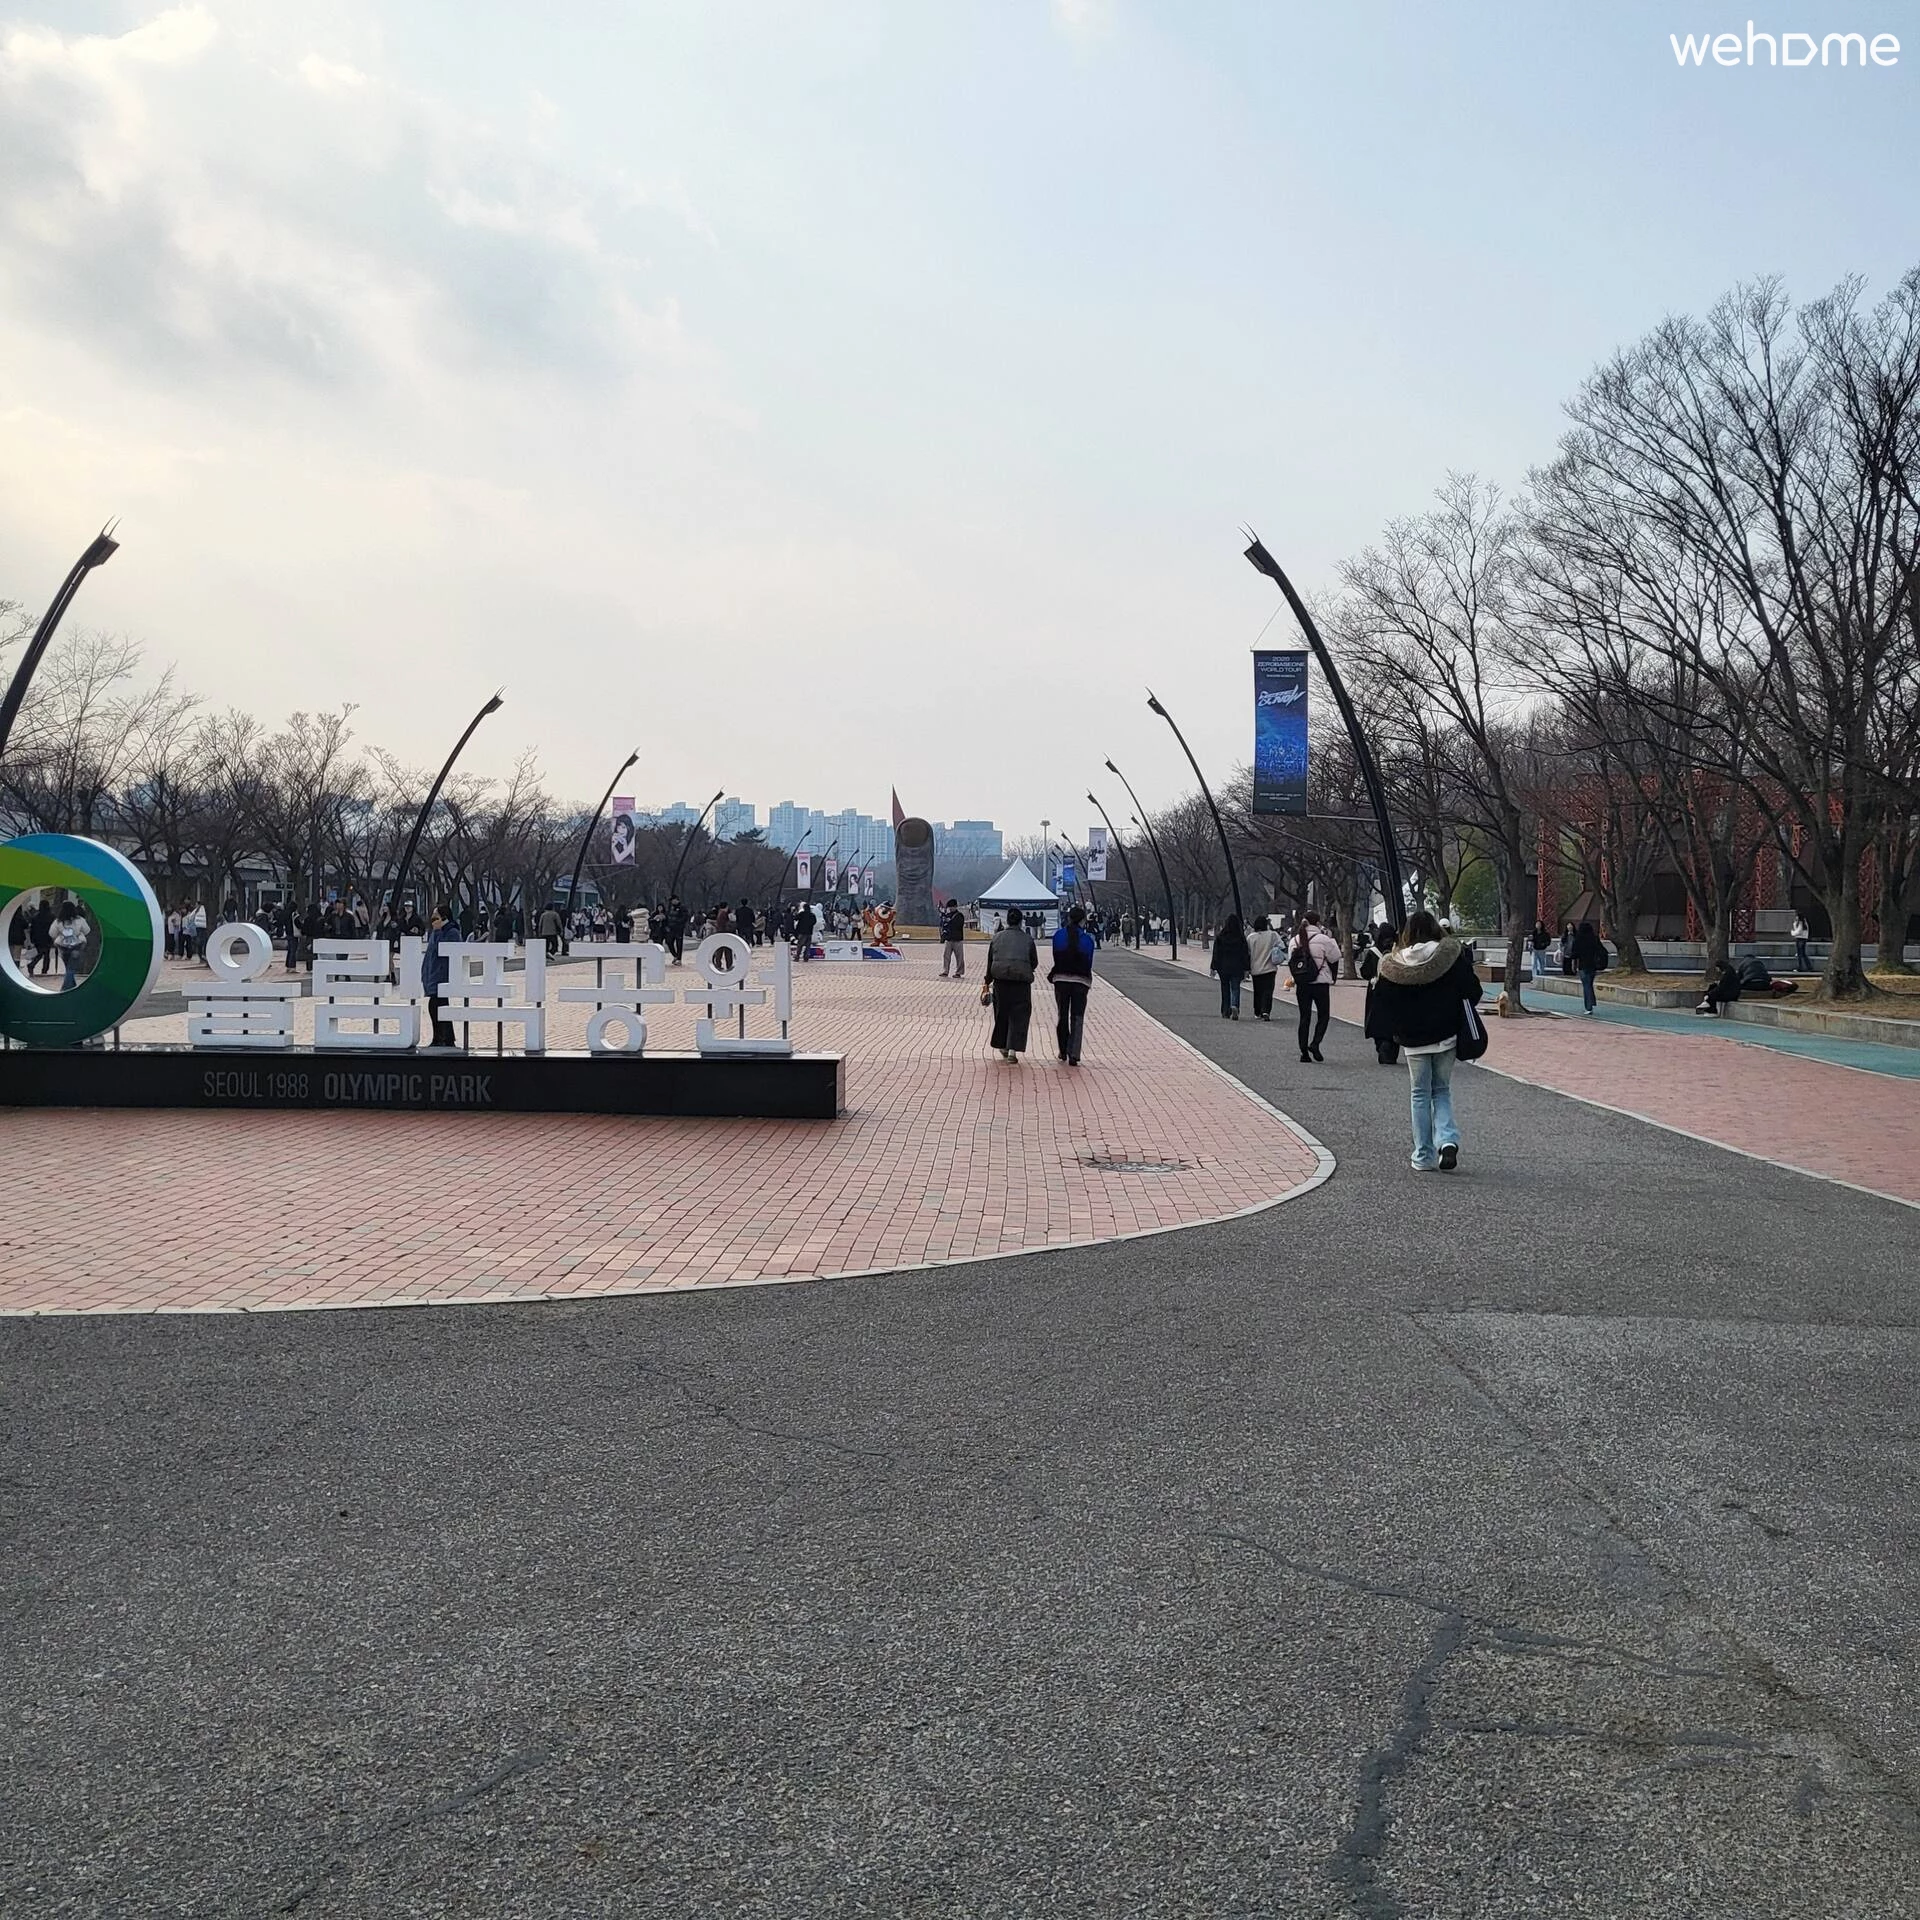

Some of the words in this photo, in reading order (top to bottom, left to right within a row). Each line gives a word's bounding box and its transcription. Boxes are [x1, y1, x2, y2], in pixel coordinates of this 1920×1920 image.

[182, 921, 793, 1054] 올림픽공원
[203, 1070, 264, 1099] SEOUL
[266, 1072, 309, 1100] 1988
[323, 1072, 423, 1102] OLYMPIC
[429, 1074, 493, 1103] PARK
